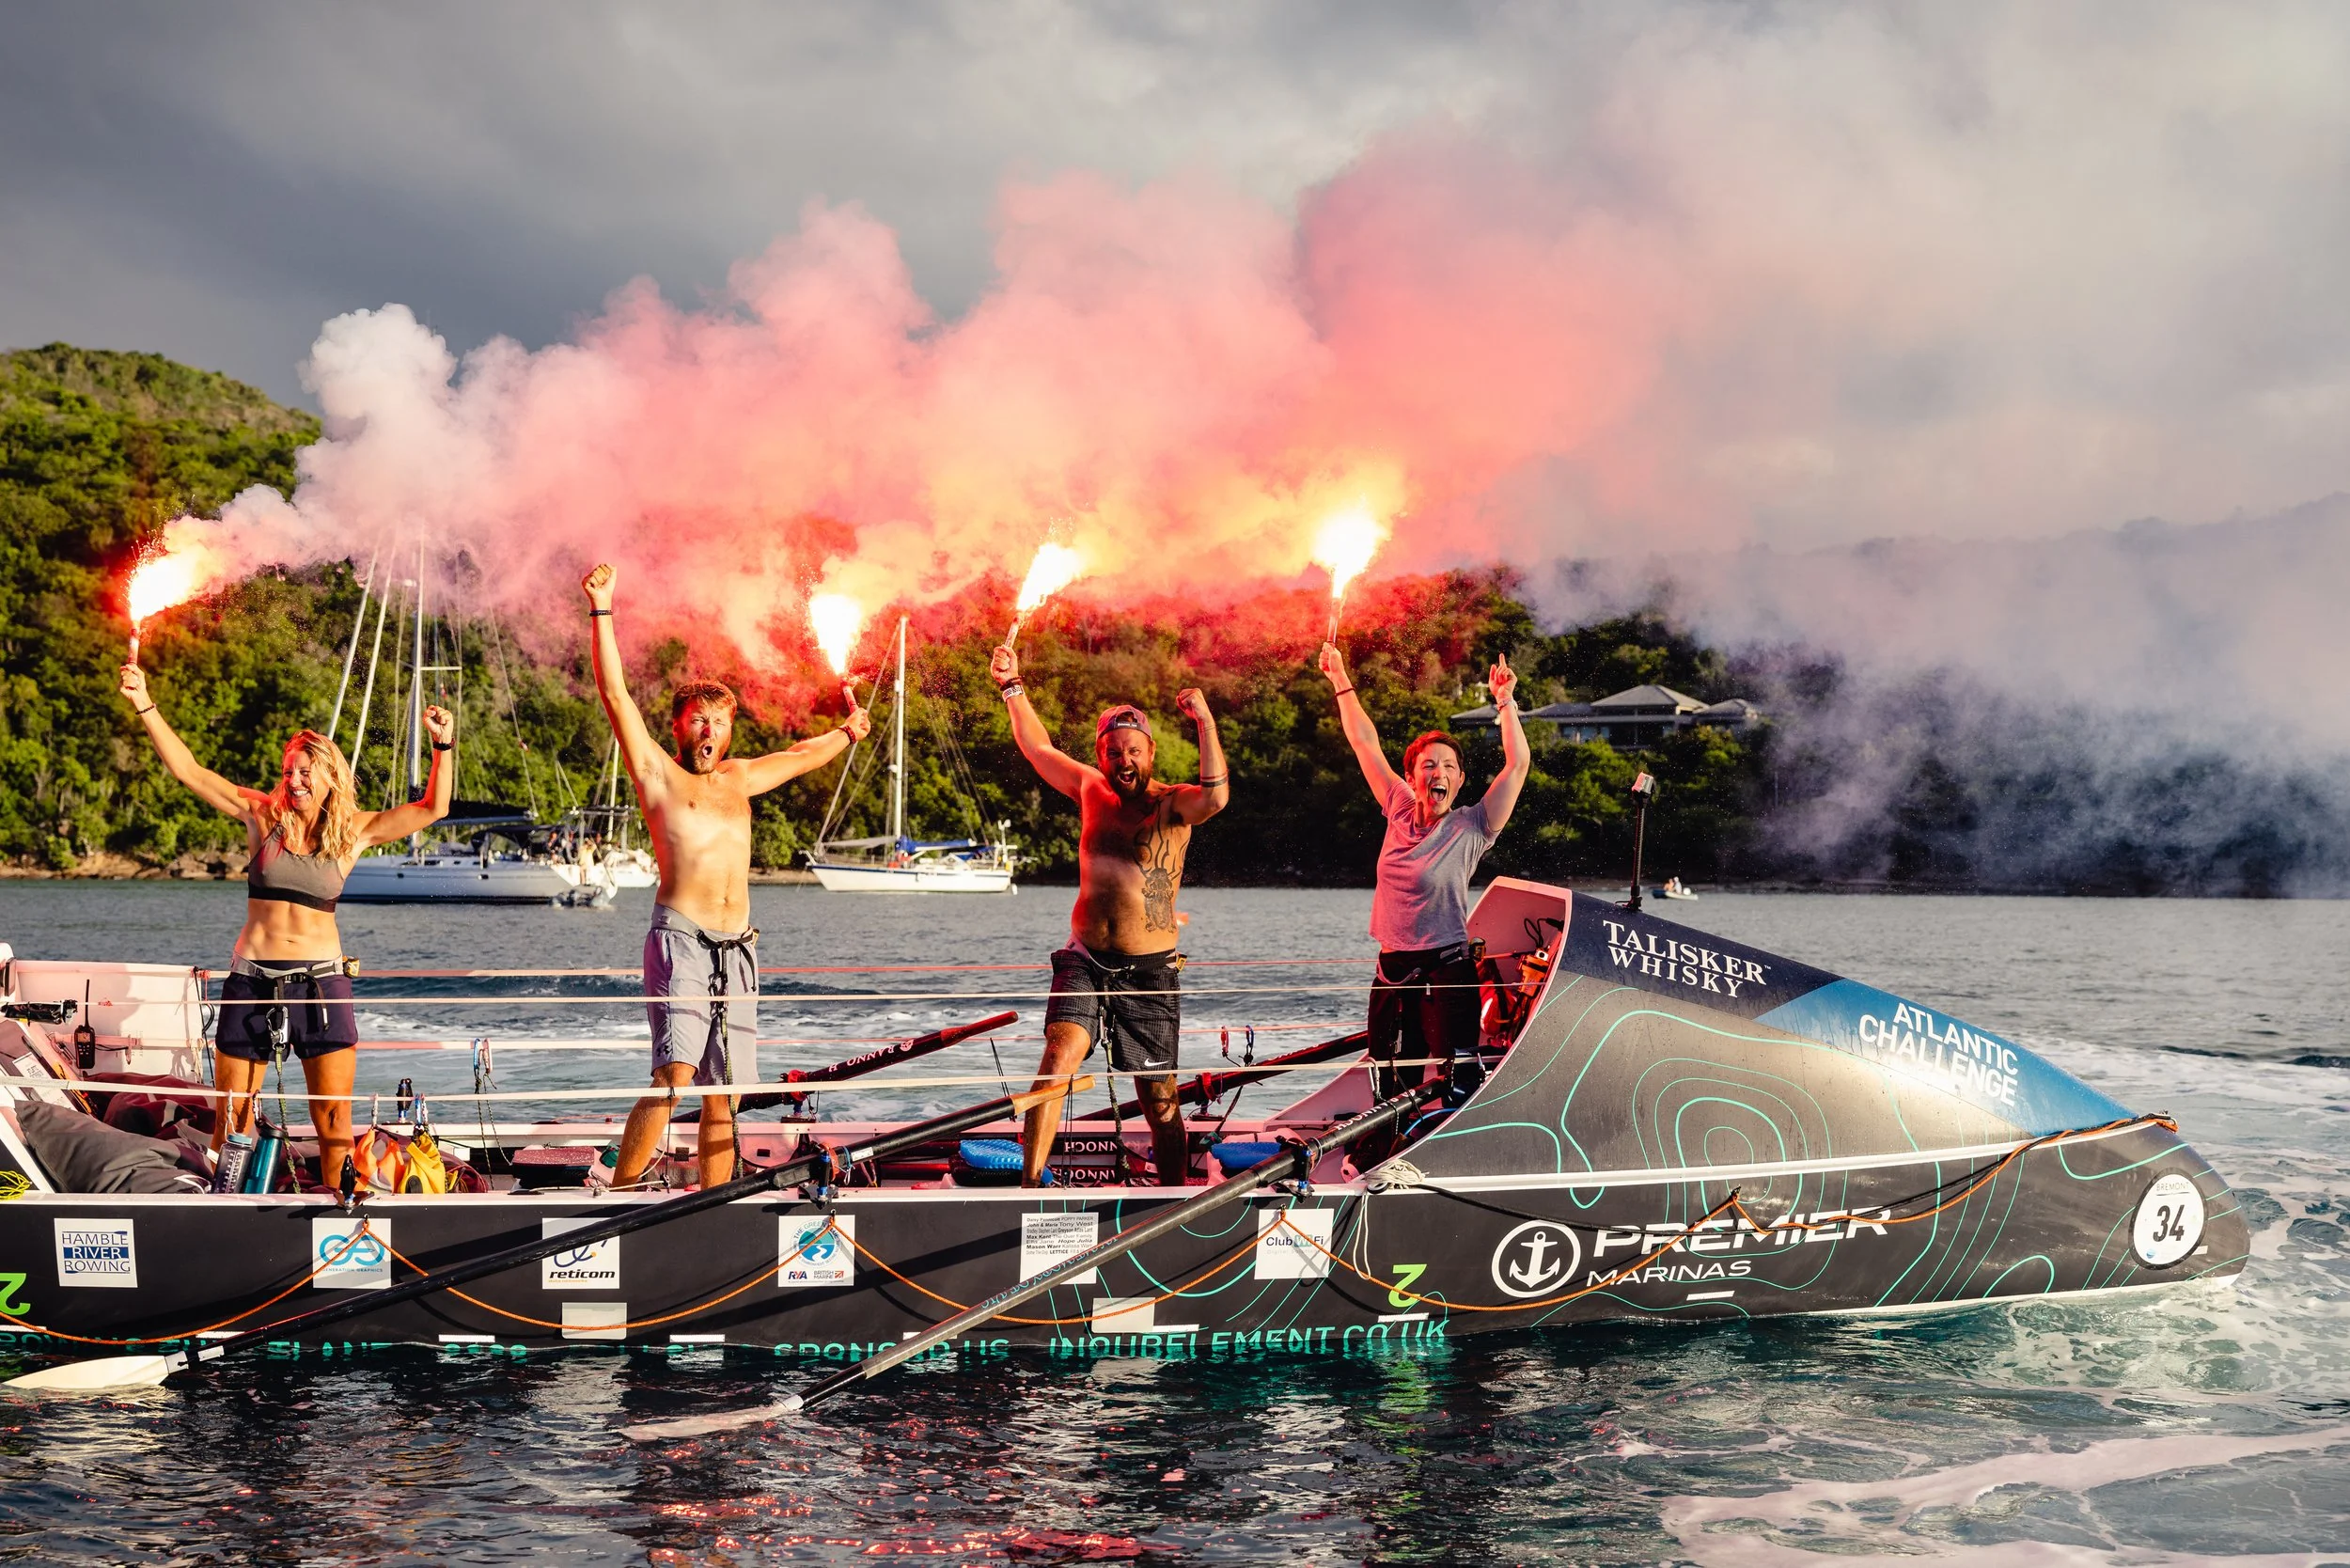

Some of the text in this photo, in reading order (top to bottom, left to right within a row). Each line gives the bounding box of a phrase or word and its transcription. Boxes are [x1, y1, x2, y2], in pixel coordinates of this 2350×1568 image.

[1607, 946, 1744, 998] WHISKY
[1893, 1002, 2019, 1075] ATLANTIC
[1858, 1014, 2019, 1107] CHALLENGE
[2156, 1182, 2190, 1192] BREMONT
[2153, 1204, 2186, 1242] 34
[1593, 1205, 1892, 1257] PREMIER
[62, 1233, 129, 1246] HAMBLE
[1265, 1236, 1293, 1247] Club
[72, 1247, 122, 1259] RIVER
[64, 1260, 131, 1272] ROWING
[549, 1269, 616, 1279] reticom
[788, 1271, 807, 1279] RYA
[1586, 1260, 1753, 1288] MARINAS
